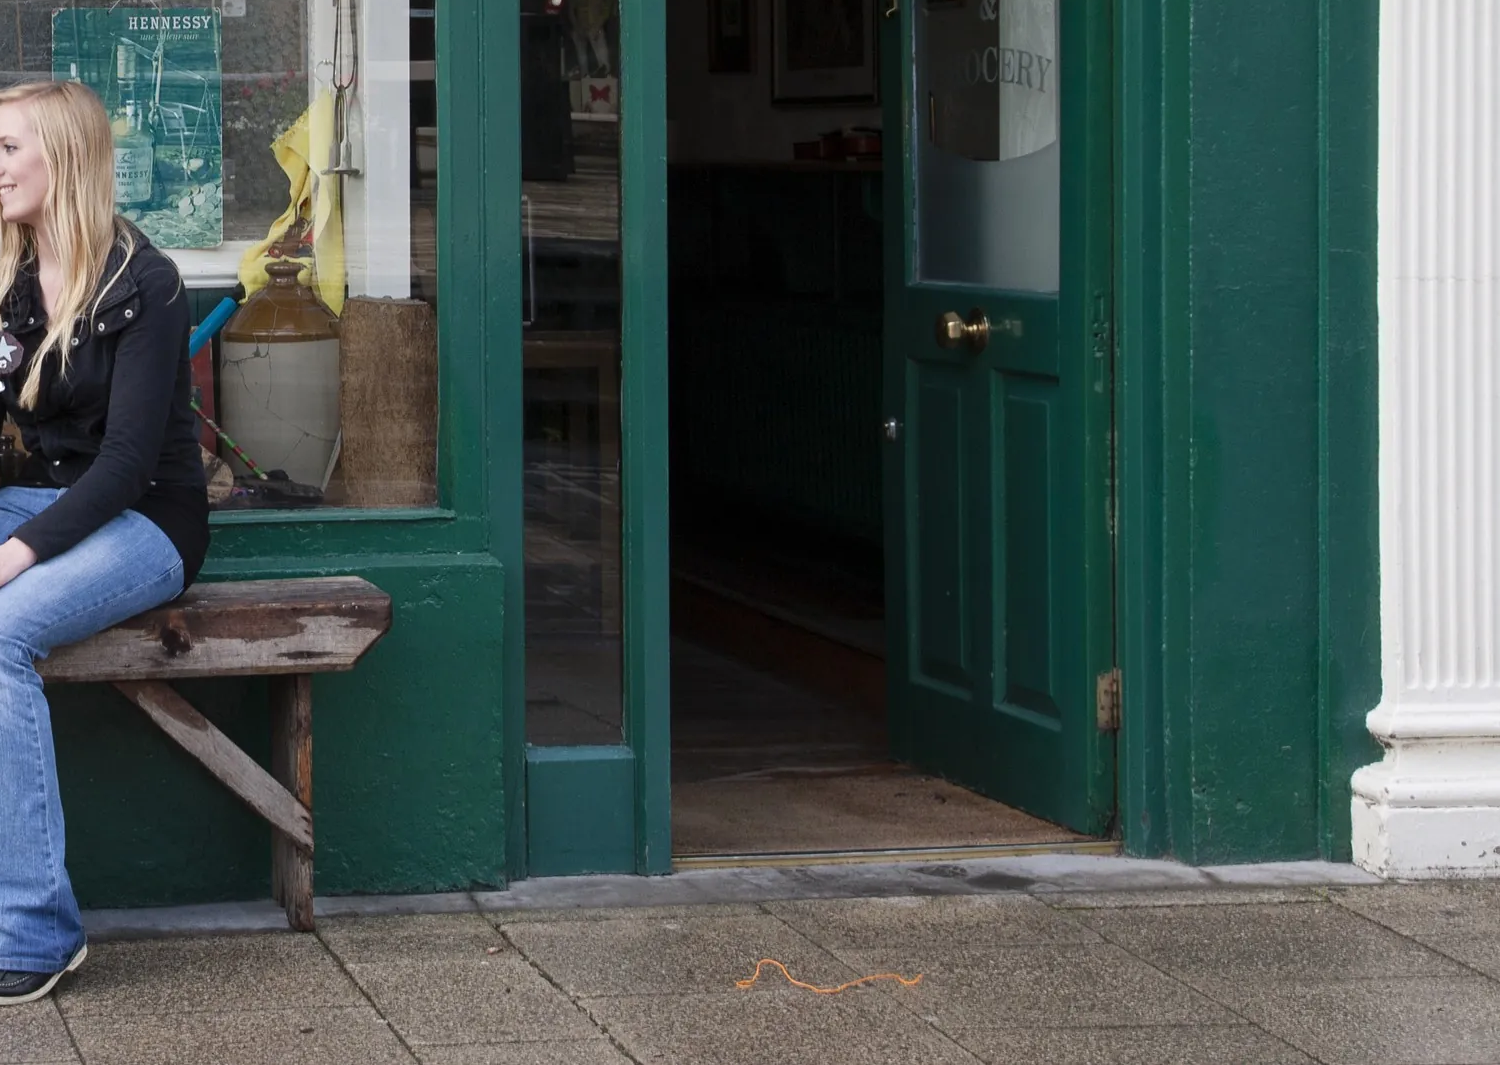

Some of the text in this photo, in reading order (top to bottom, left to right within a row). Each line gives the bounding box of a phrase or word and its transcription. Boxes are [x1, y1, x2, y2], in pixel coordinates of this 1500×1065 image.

[128, 15, 211, 30] HENNESSY
[964, 45, 1052, 93] OCERY
[115, 169, 149, 179] NNESSY
